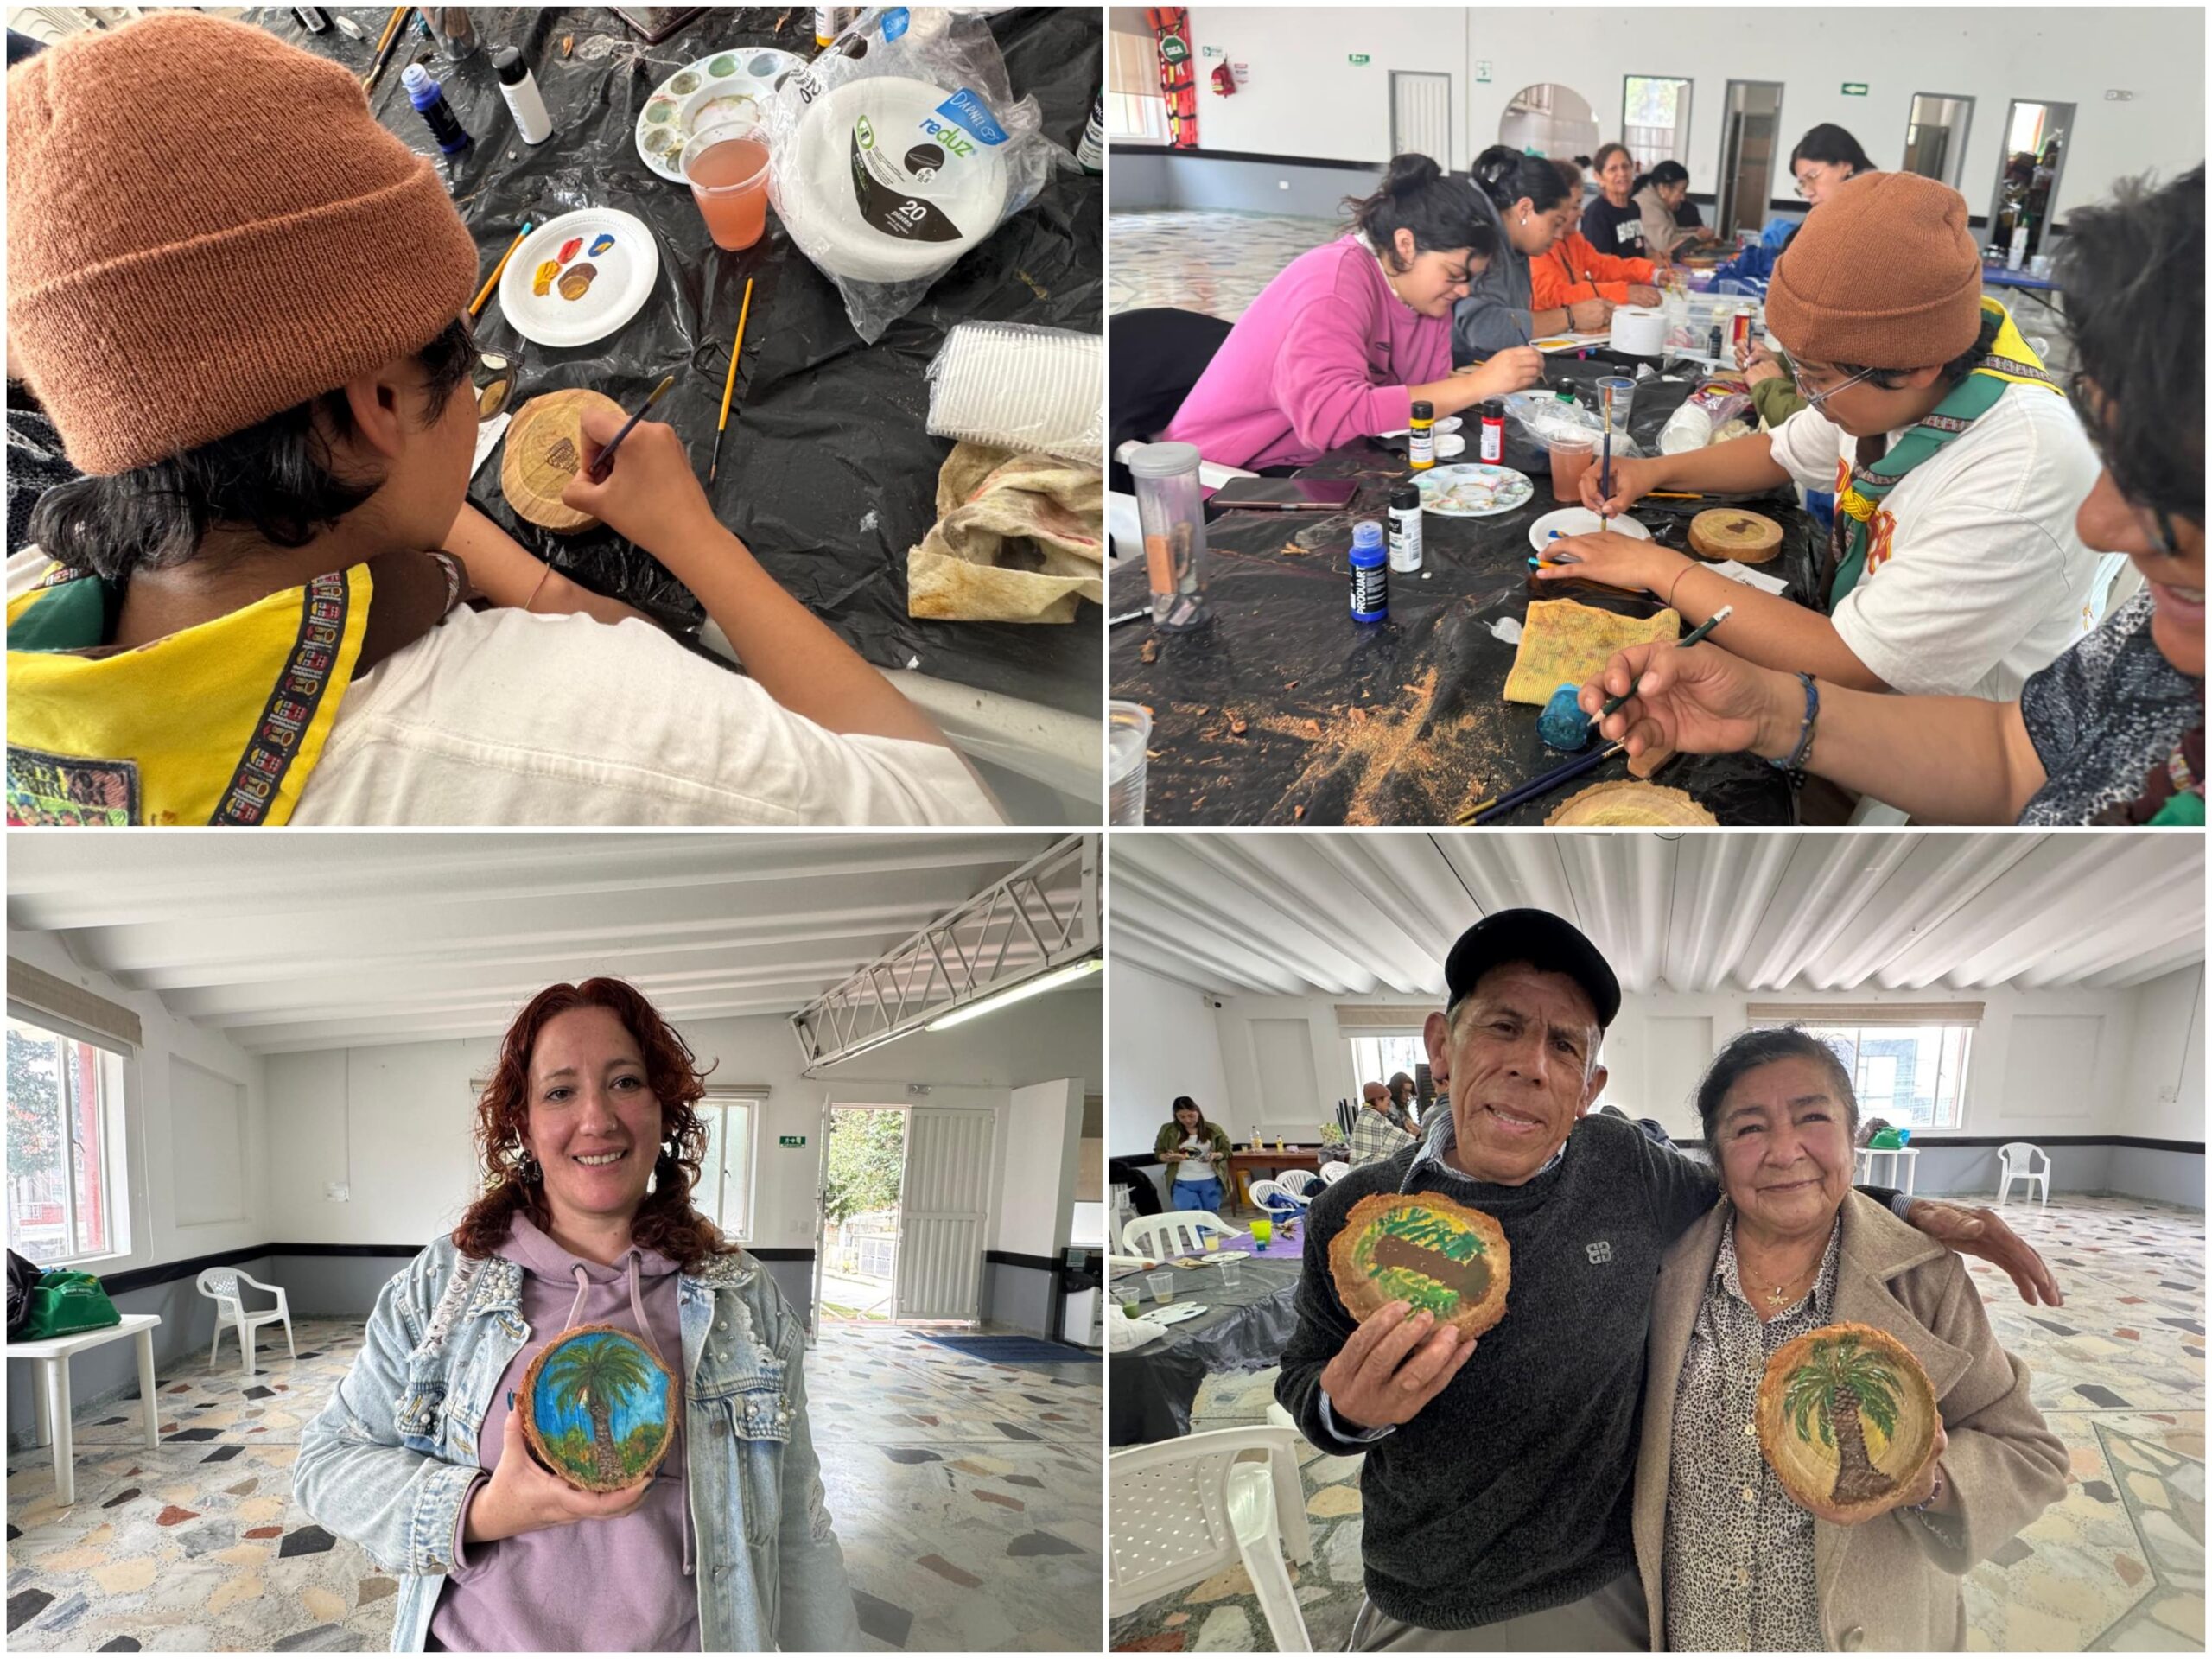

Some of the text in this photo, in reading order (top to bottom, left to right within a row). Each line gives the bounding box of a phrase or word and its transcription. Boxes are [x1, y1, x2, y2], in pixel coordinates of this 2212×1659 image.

[950, 92, 985, 127] DARNEL
[919, 118, 973, 158] reduz
[891, 210, 913, 228] plates
[899, 200, 927, 221] 20
[1616, 219, 1643, 243] BOSTO
[1356, 564, 1366, 614] PRODUART
